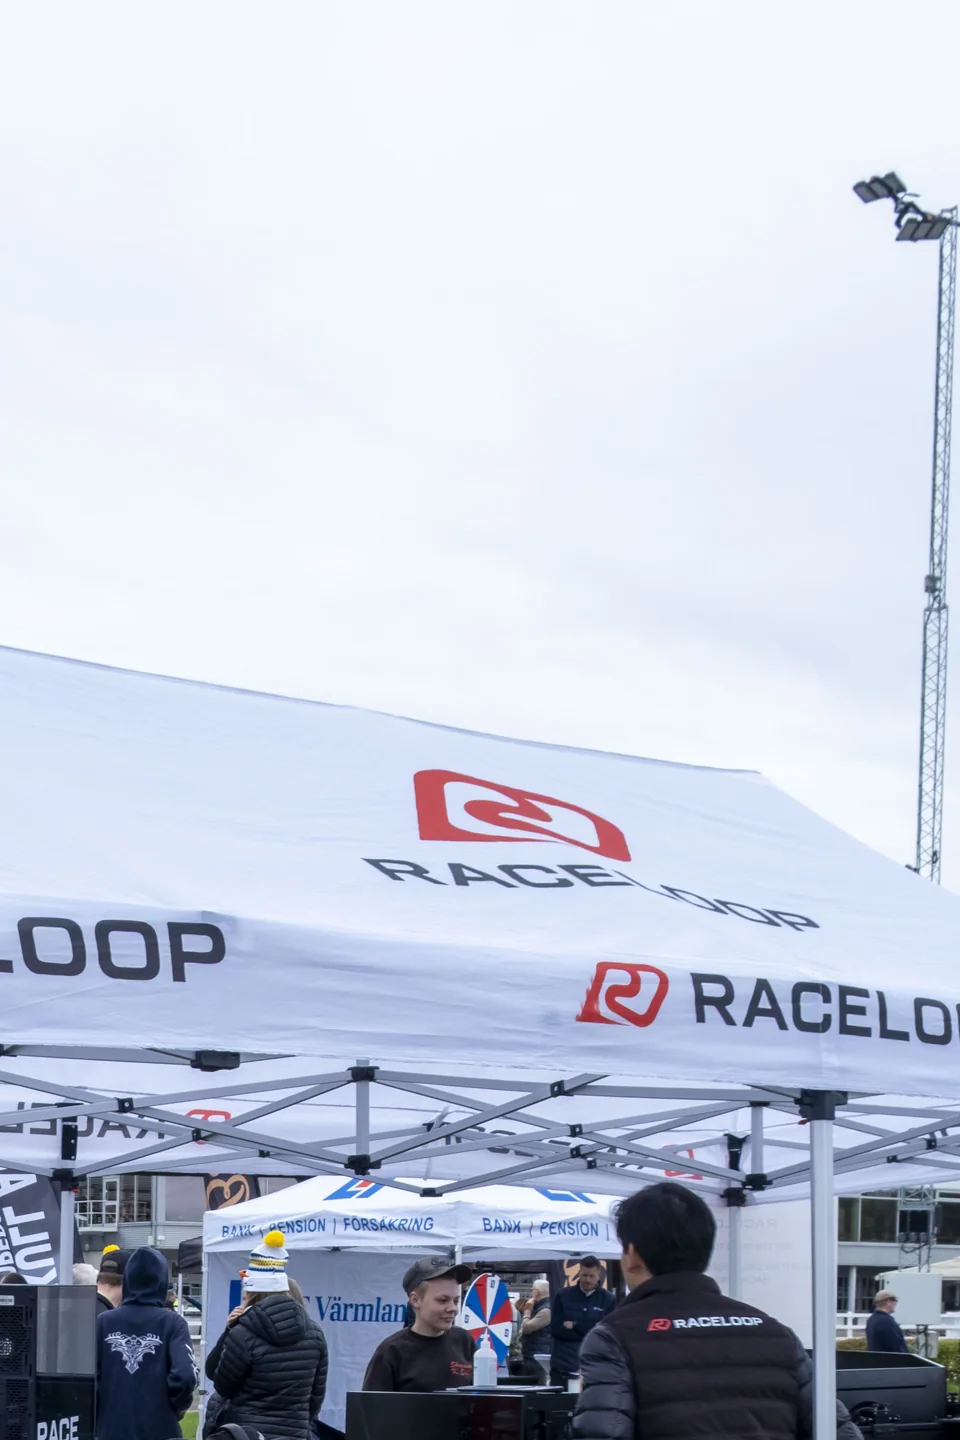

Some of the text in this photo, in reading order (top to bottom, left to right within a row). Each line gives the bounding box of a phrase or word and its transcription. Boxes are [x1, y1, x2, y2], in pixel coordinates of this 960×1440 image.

[362, 857, 820, 932] RACELOOP
[689, 972, 960, 1046] RACELO
[221, 1214, 434, 1238] BANK PENSION FÖRSÄKRING
[482, 1217, 599, 1238] BANK PENSION
[673, 1316, 763, 1329] RACELOOP
